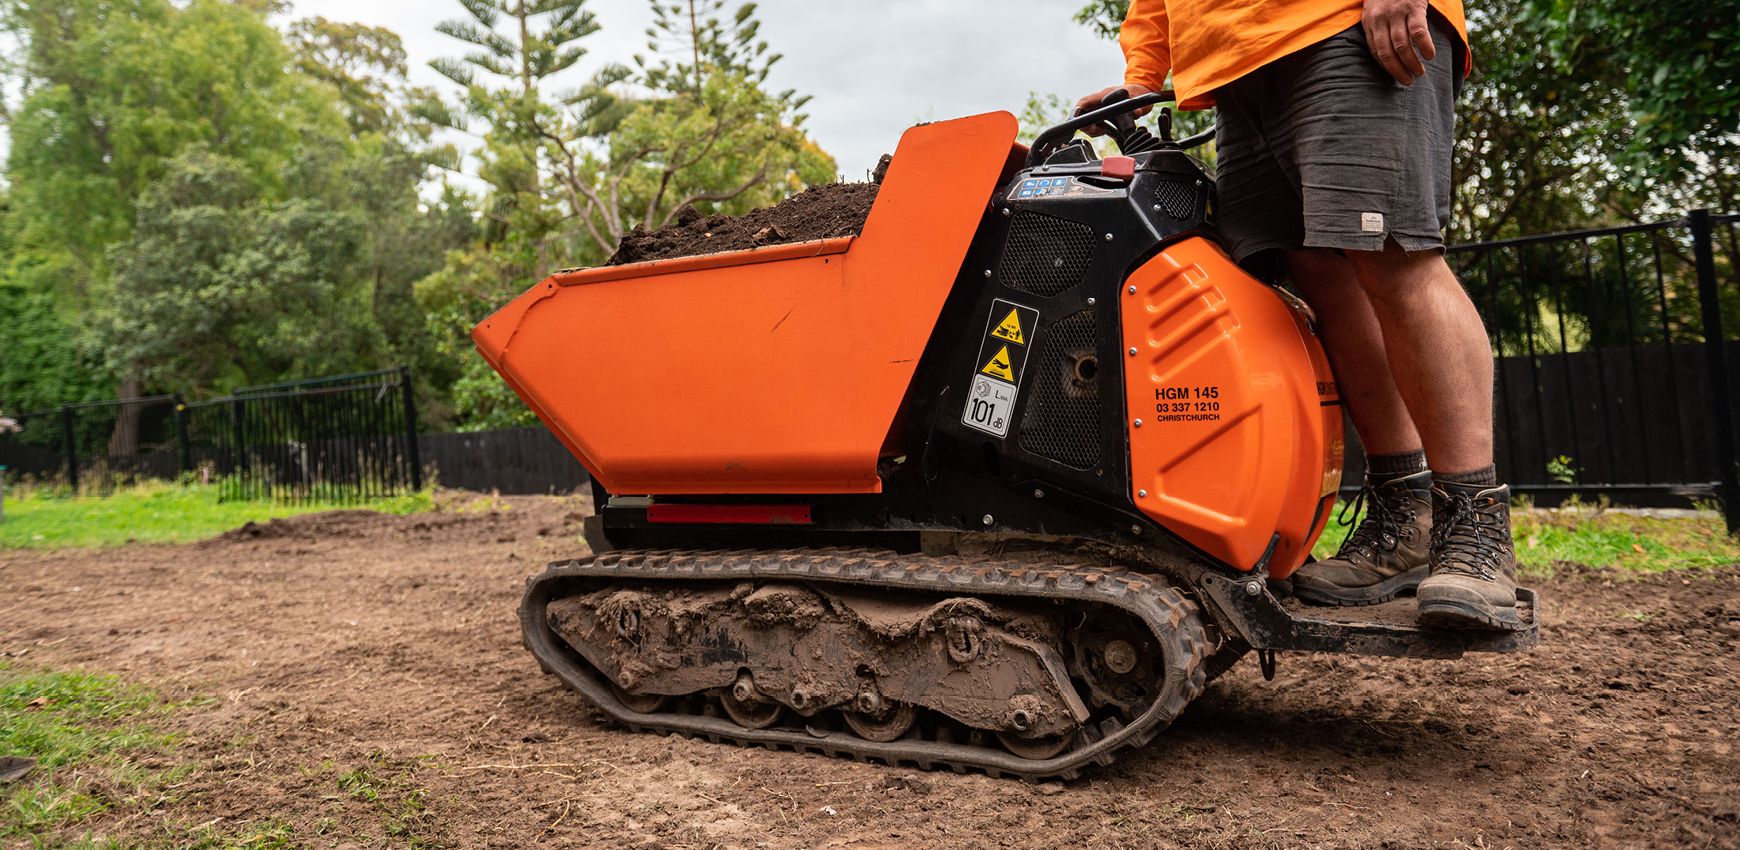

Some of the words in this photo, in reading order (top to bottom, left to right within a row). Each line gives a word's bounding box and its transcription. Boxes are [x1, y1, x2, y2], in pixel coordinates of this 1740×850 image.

[1155, 387, 1189, 400] HGM
[1194, 386, 1219, 399] 145
[971, 398, 995, 425] 101
[993, 417, 1003, 429] dB
[1156, 403, 1169, 413] 03
[1171, 402, 1190, 412] 337
[1194, 401, 1220, 412] 1210
[1157, 413, 1220, 422] CHRISTCHURCH
